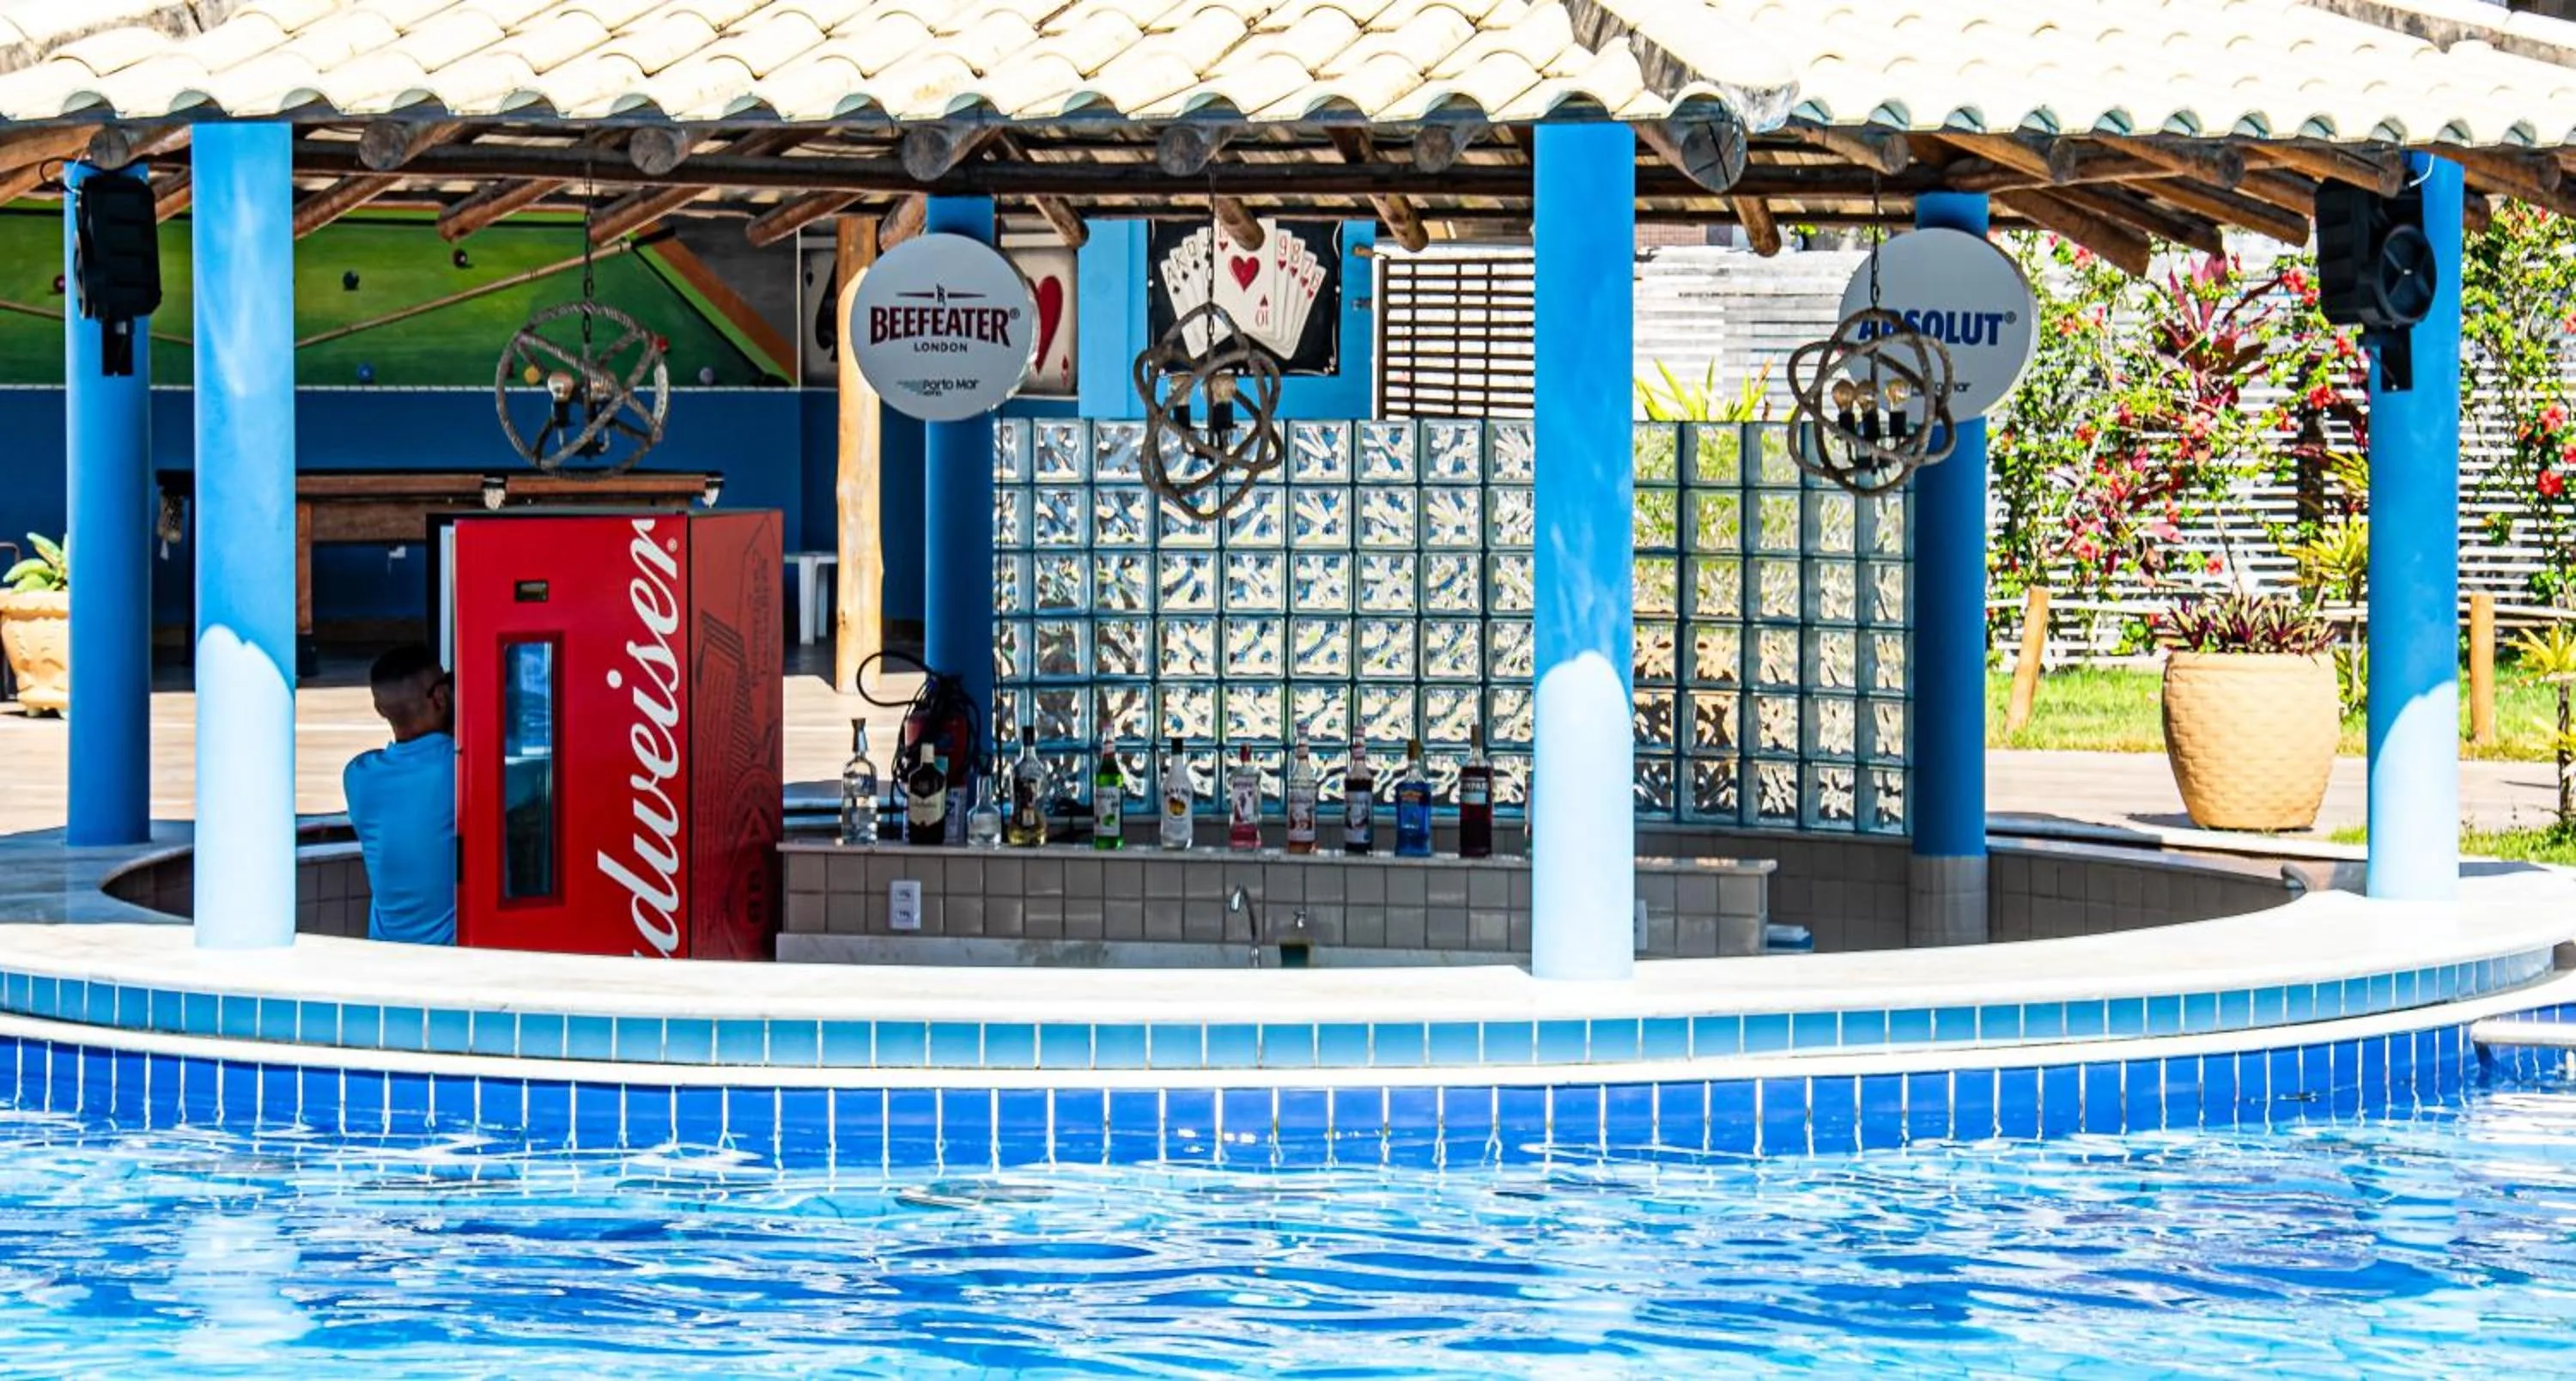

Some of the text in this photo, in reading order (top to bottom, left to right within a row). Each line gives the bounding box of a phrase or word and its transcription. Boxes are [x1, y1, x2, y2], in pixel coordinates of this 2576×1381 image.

[1279, 235, 1287, 256] 9
[1305, 257, 1315, 275] 7
[870, 306, 1011, 347] BEEFEATER
[914, 342, 968, 353] LONDON
[923, 378, 980, 391] Porto Mar
[598, 519, 680, 958] dweiser
